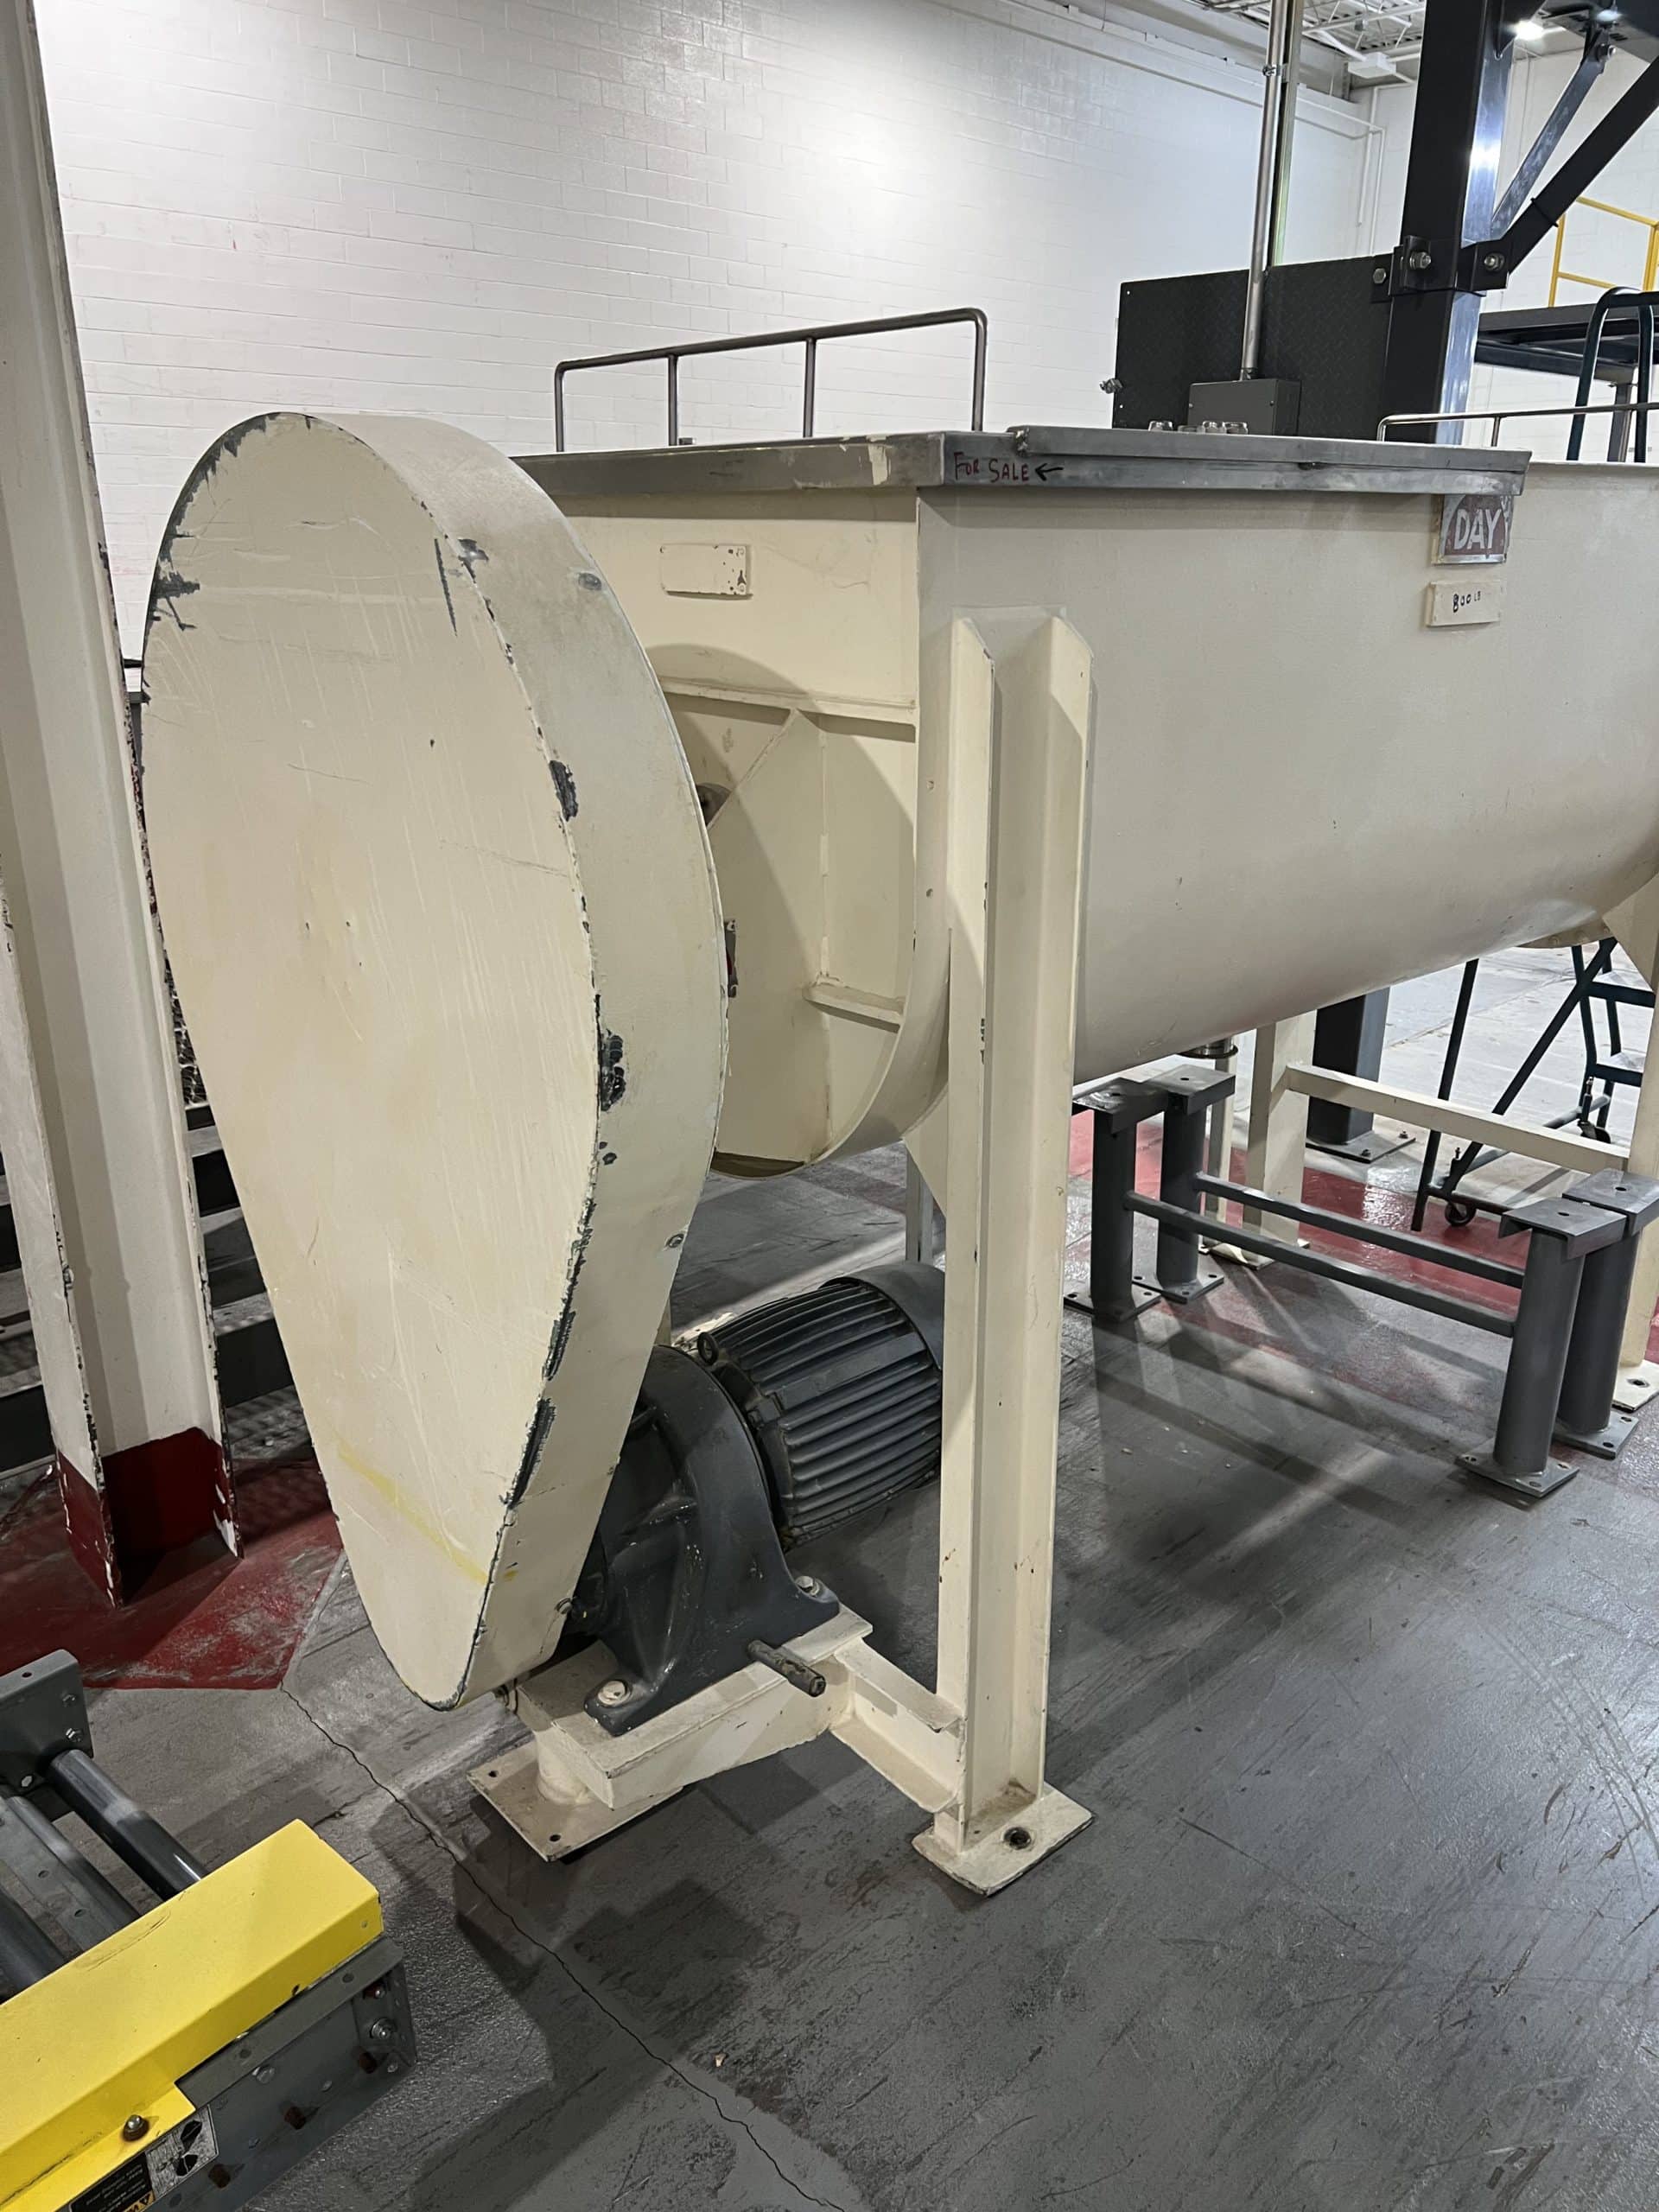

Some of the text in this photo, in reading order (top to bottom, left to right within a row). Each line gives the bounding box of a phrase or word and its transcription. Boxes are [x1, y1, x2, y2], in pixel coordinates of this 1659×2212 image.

[953, 451, 1030, 483] FOR SALE
[1453, 508, 1503, 550] DAY
